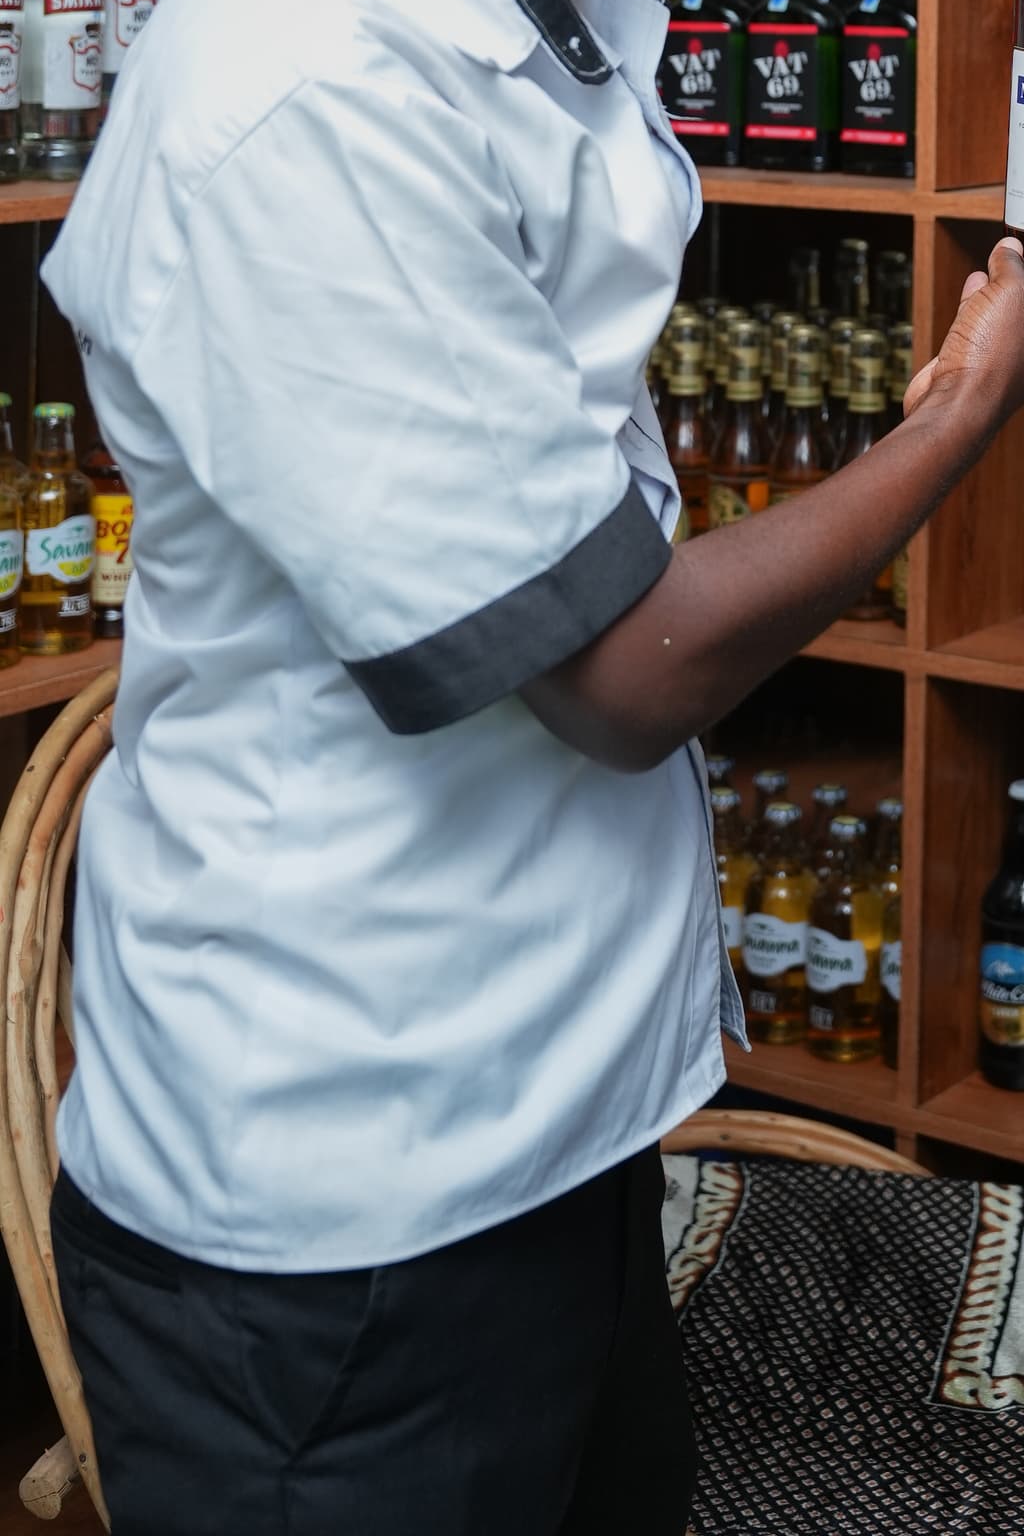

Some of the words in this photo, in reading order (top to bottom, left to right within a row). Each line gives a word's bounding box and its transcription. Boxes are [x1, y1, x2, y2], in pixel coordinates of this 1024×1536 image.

[668, 48, 721, 75] VAT
[754, 50, 808, 78] VAT
[848, 54, 899, 82] VAT
[681, 72, 713, 95] 69
[766, 75, 800, 98] 69
[860, 79, 891, 102] 69
[97, 520, 133, 538] BO
[39, 535, 92, 564] Savan
[115, 537, 129, 564] 7
